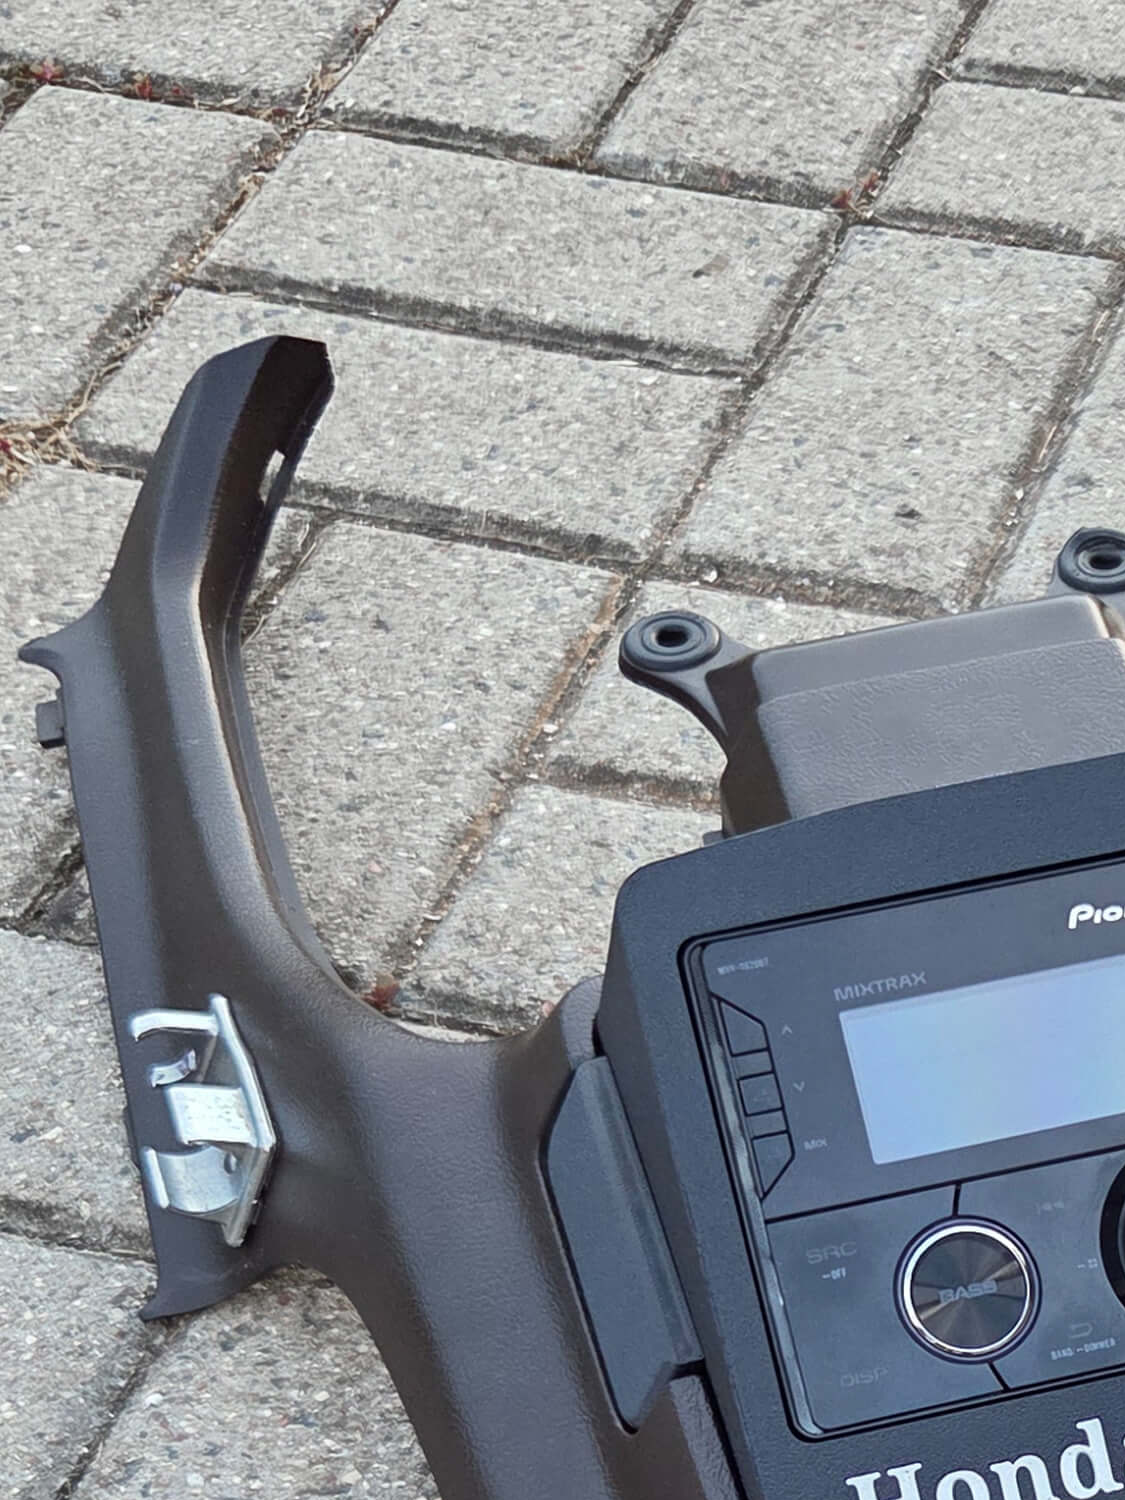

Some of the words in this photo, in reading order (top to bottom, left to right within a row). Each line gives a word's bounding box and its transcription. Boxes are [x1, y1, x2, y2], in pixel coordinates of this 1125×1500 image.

[833, 971, 928, 1002] MIXTRAX
[806, 1241, 858, 1265] SRC
[938, 1279, 998, 1303] BASS
[840, 1366, 889, 1388] DISP
